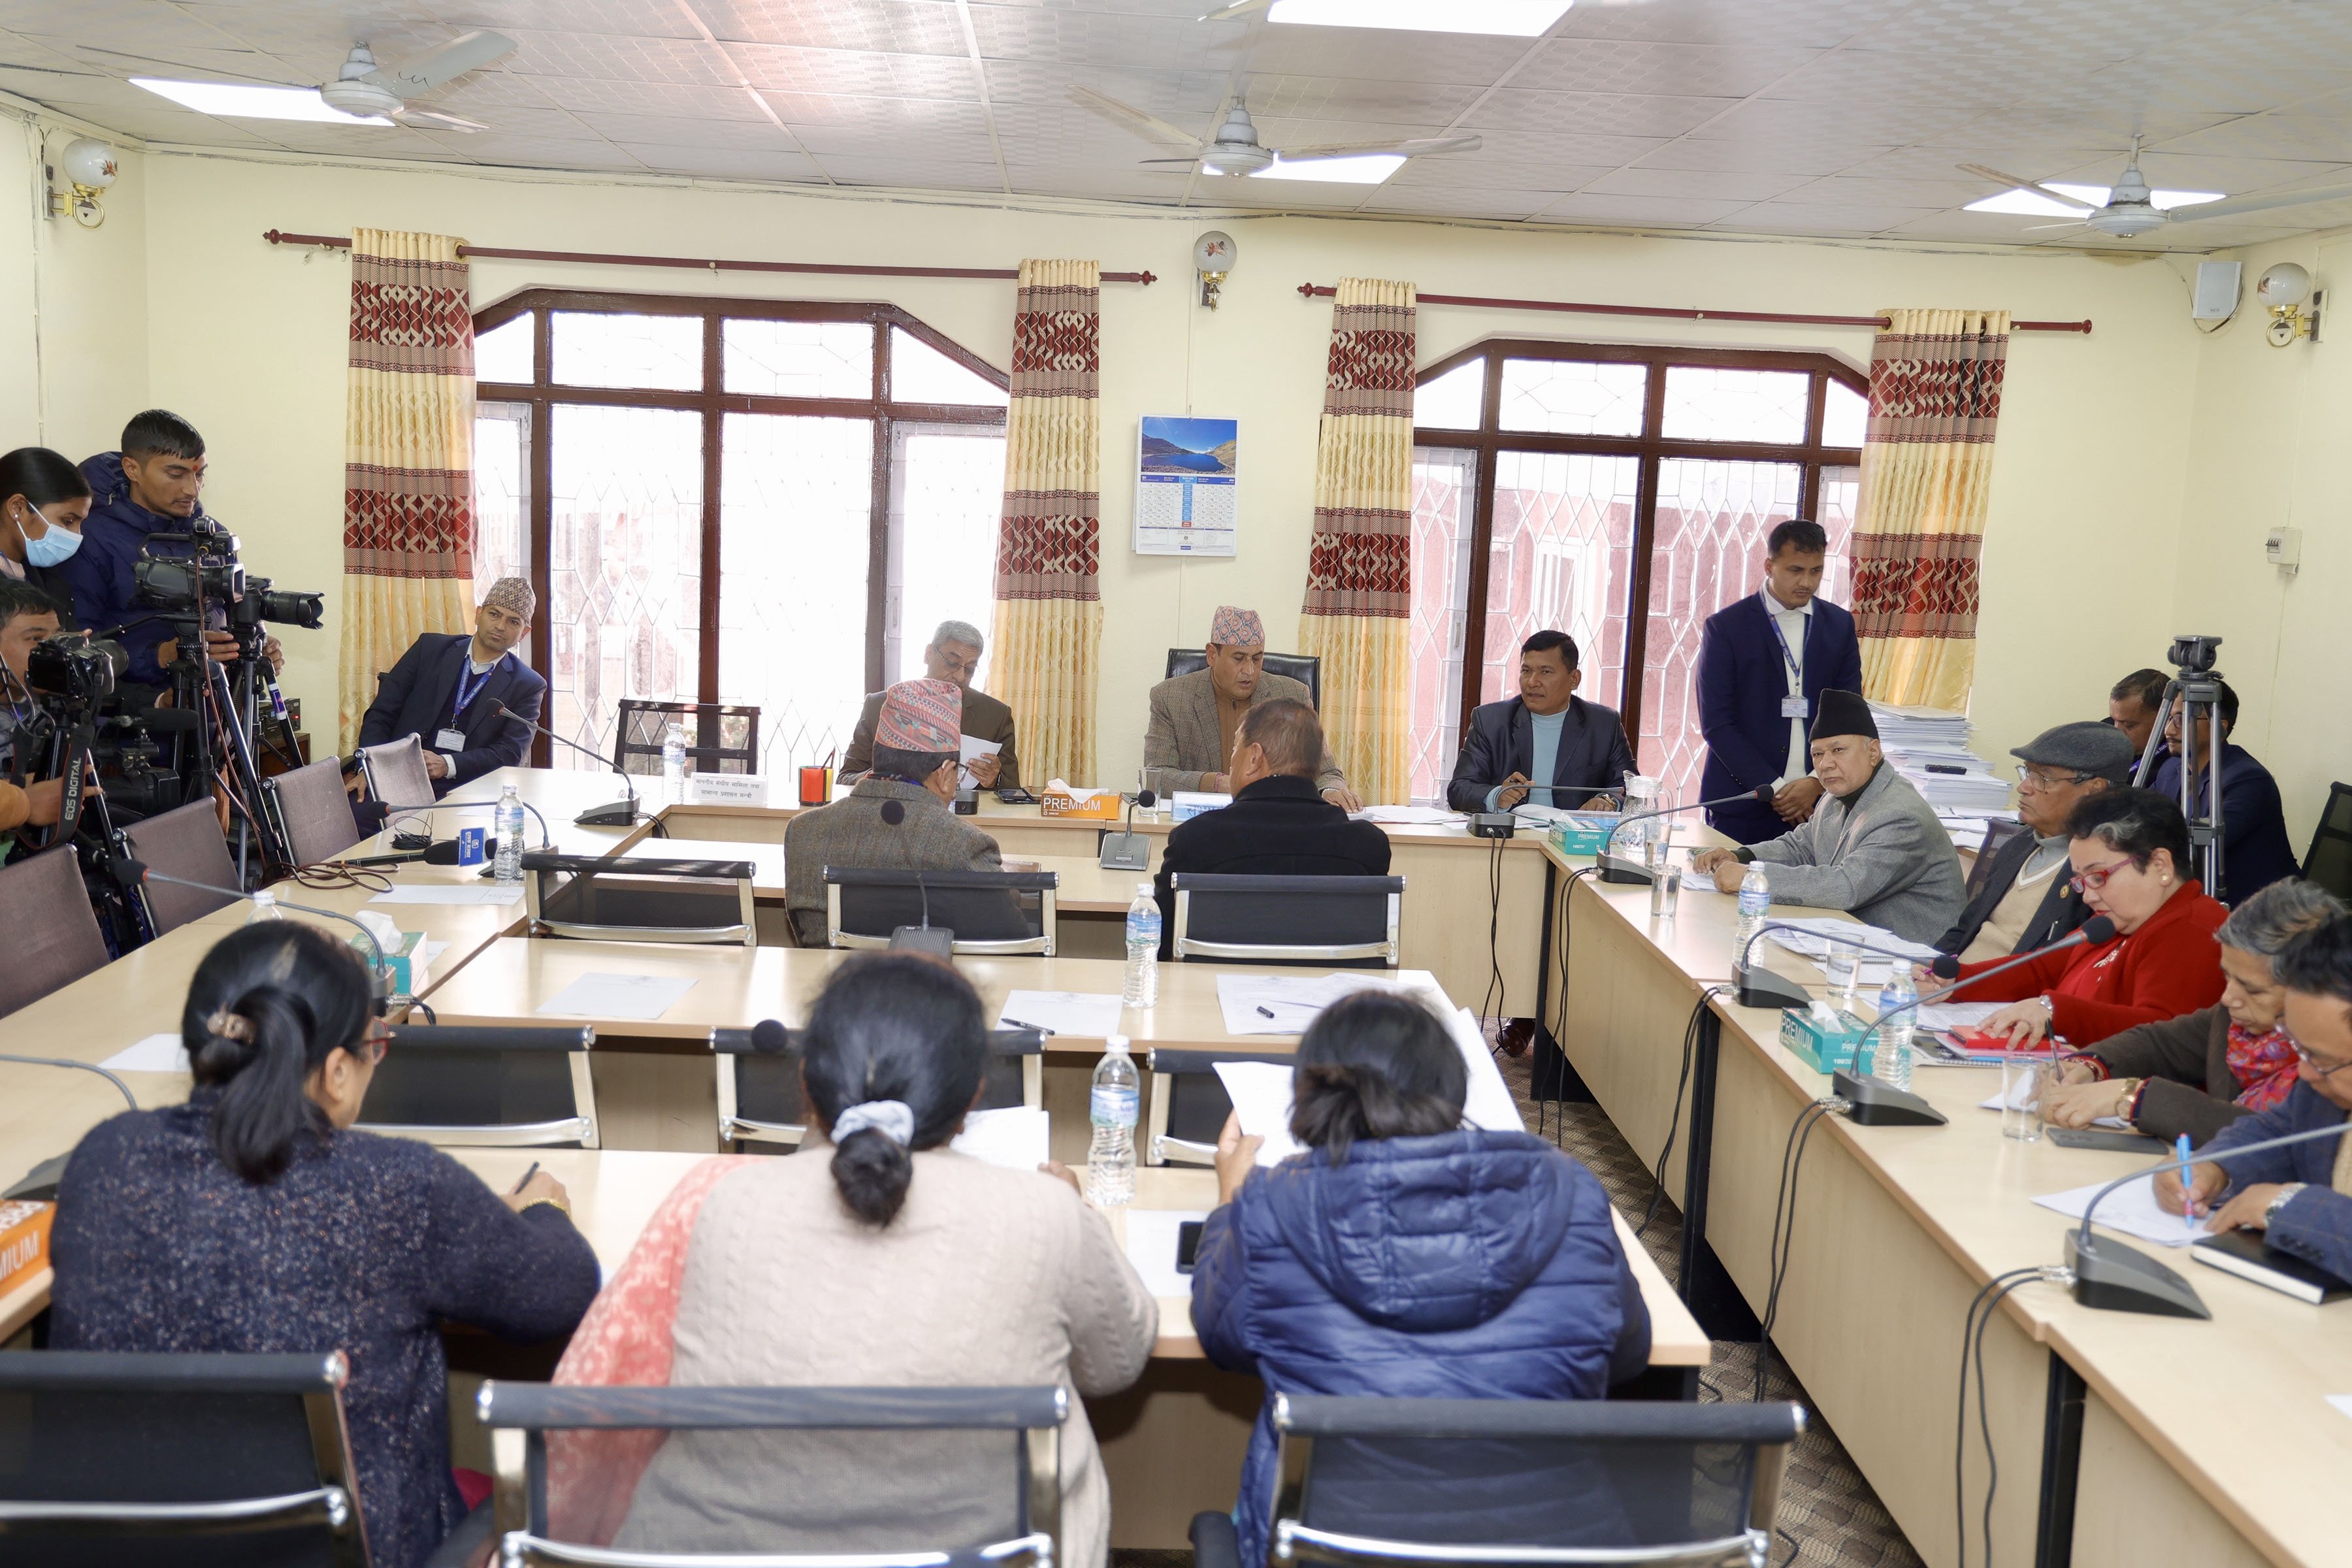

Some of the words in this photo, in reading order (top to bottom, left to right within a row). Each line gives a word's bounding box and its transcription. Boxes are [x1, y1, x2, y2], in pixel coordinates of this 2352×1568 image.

[68, 757, 82, 797] DIGITAL
[65, 798, 76, 821] EOS
[1043, 797, 1102, 811] PREMIUM
[1782, 1015, 1814, 1053] PREMIUM
[1842, 1043, 1876, 1052] PREIUM
